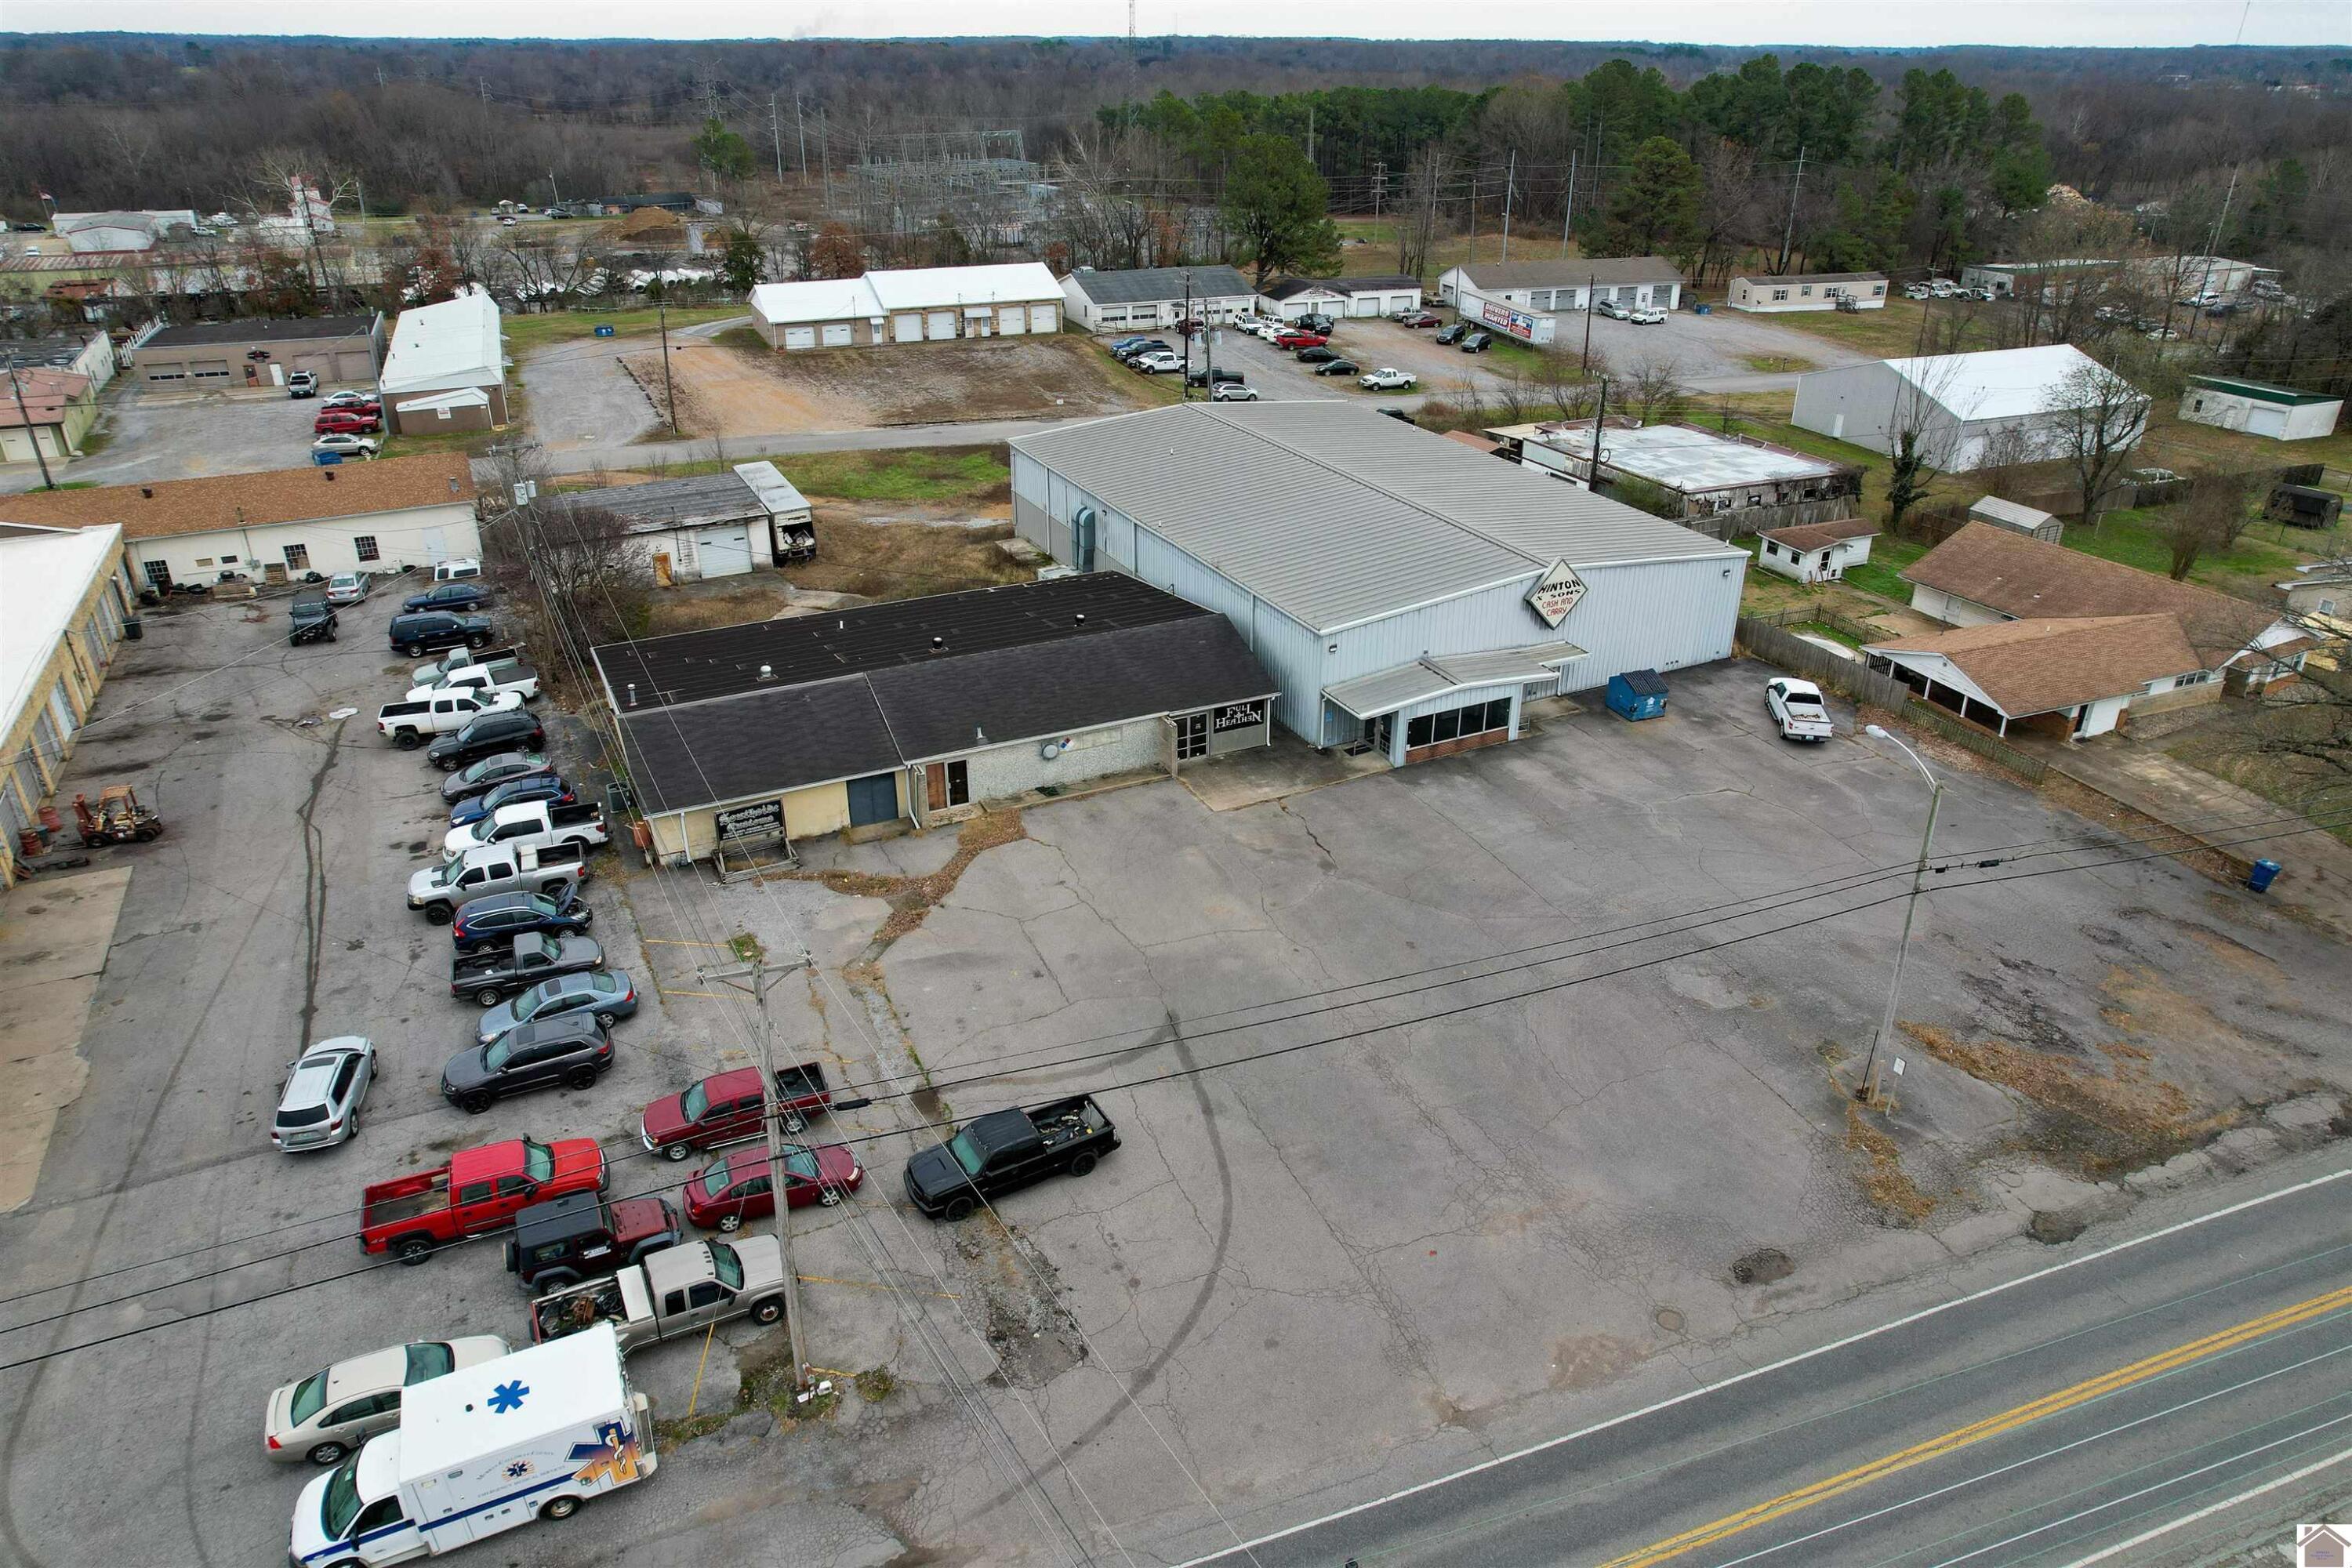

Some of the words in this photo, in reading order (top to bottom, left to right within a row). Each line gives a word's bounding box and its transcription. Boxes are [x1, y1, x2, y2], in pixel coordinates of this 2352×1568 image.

[1485, 304, 1509, 317] DRIVERS
[1484, 312, 1508, 325] WANTED
[1537, 579, 1581, 594] HINTON
[1550, 589, 1581, 599] SONS
[1542, 599, 1559, 609] CASH
[1560, 597, 1573, 606] AND
[1546, 606, 1567, 617] CARRY
[1226, 704, 1253, 718] FULL
